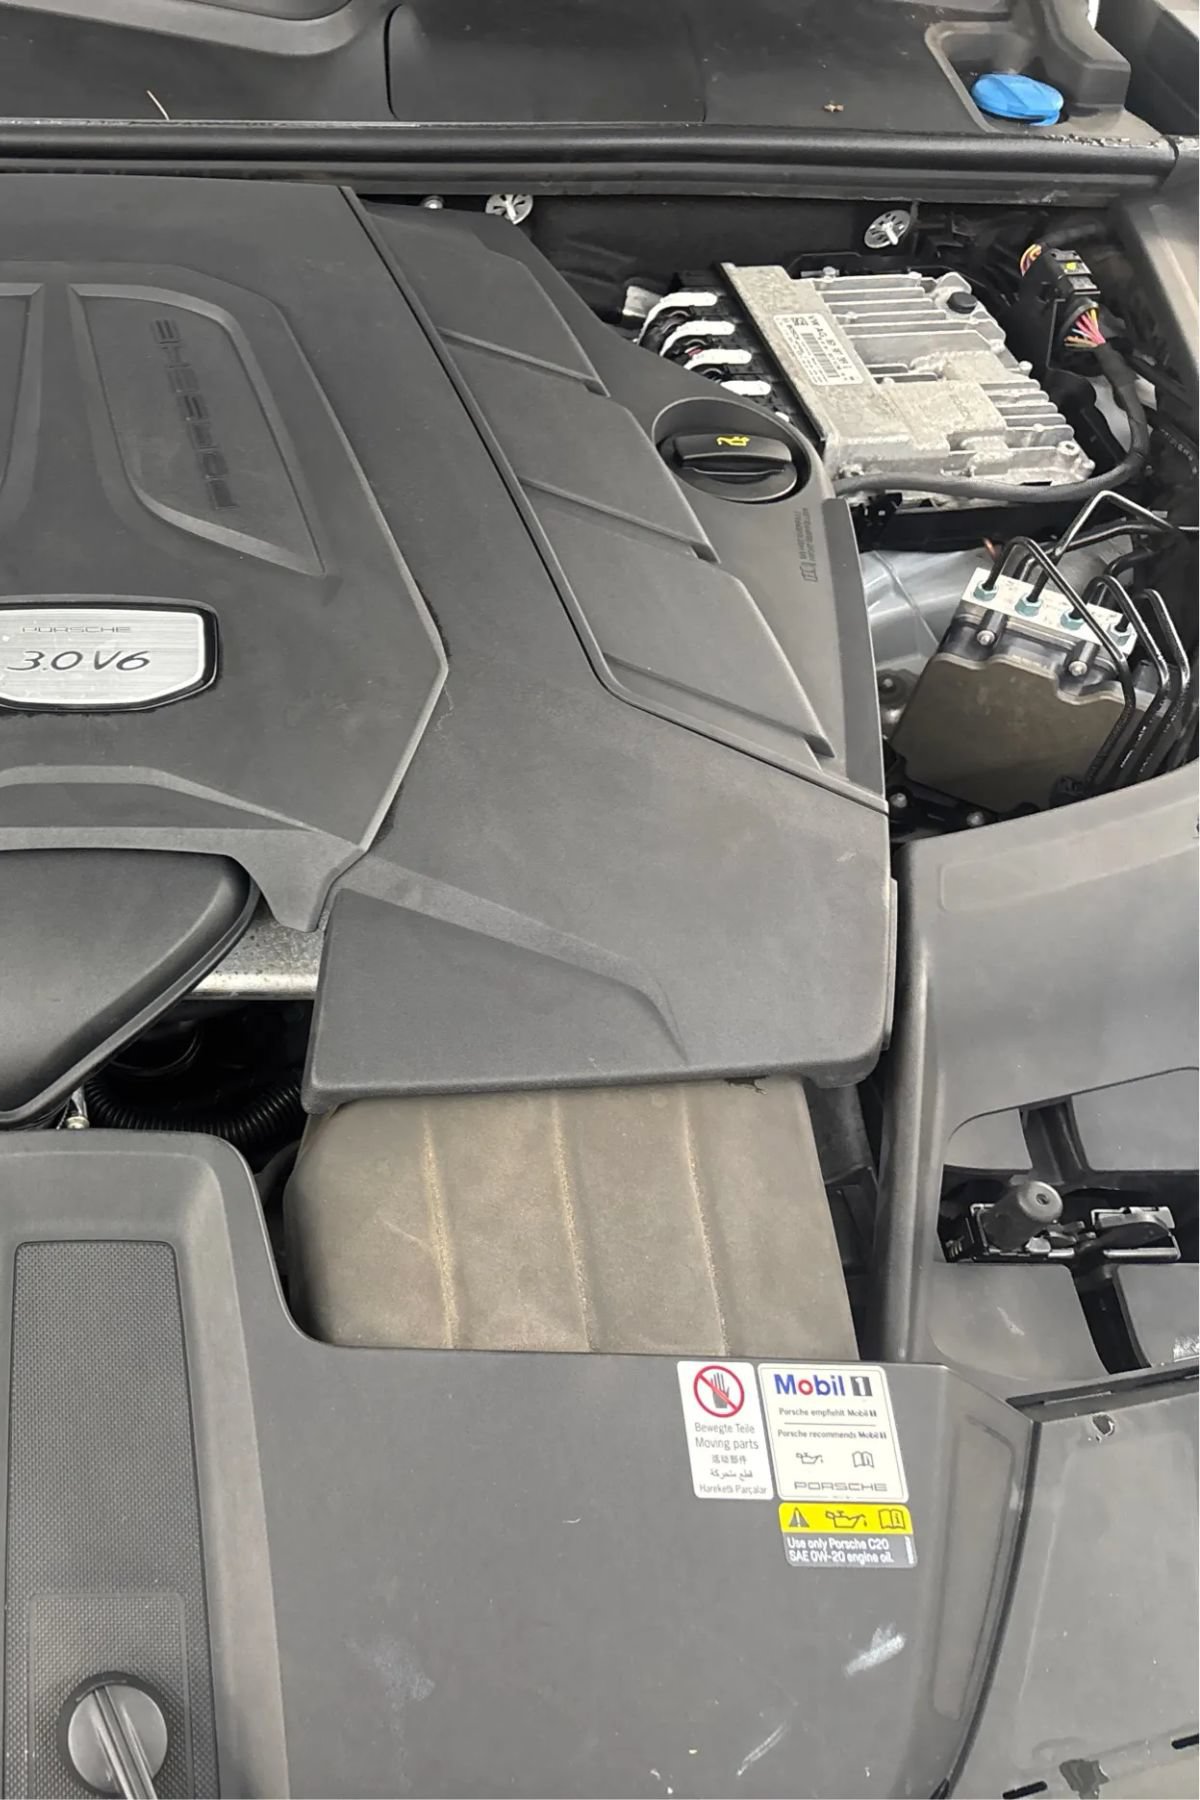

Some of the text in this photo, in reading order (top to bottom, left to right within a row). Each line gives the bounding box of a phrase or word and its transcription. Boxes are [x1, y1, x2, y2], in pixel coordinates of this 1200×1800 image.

[22, 625, 132, 634] PORSCHE
[6, 650, 151, 672] 3.0 V6
[773, 1373, 872, 1397] Mobil 1
[778, 1407, 809, 1417] Porsche
[810, 1408, 846, 1418] empfiehlt
[847, 1408, 869, 1418] Mobil
[694, 1421, 756, 1435] Bewegte Teile
[777, 1428, 808, 1438] Porsche
[809, 1430, 857, 1440] recommends
[857, 1430, 880, 1440] Mobil
[695, 1437, 760, 1451] Moving parts
[793, 1481, 888, 1492] PORSCHE
[786, 1536, 889, 1551] Use only Porsche C20
[788, 1550, 809, 1561] SAE
[810, 1550, 845, 1562] 0W-20
[846, 1551, 879, 1565] engine
